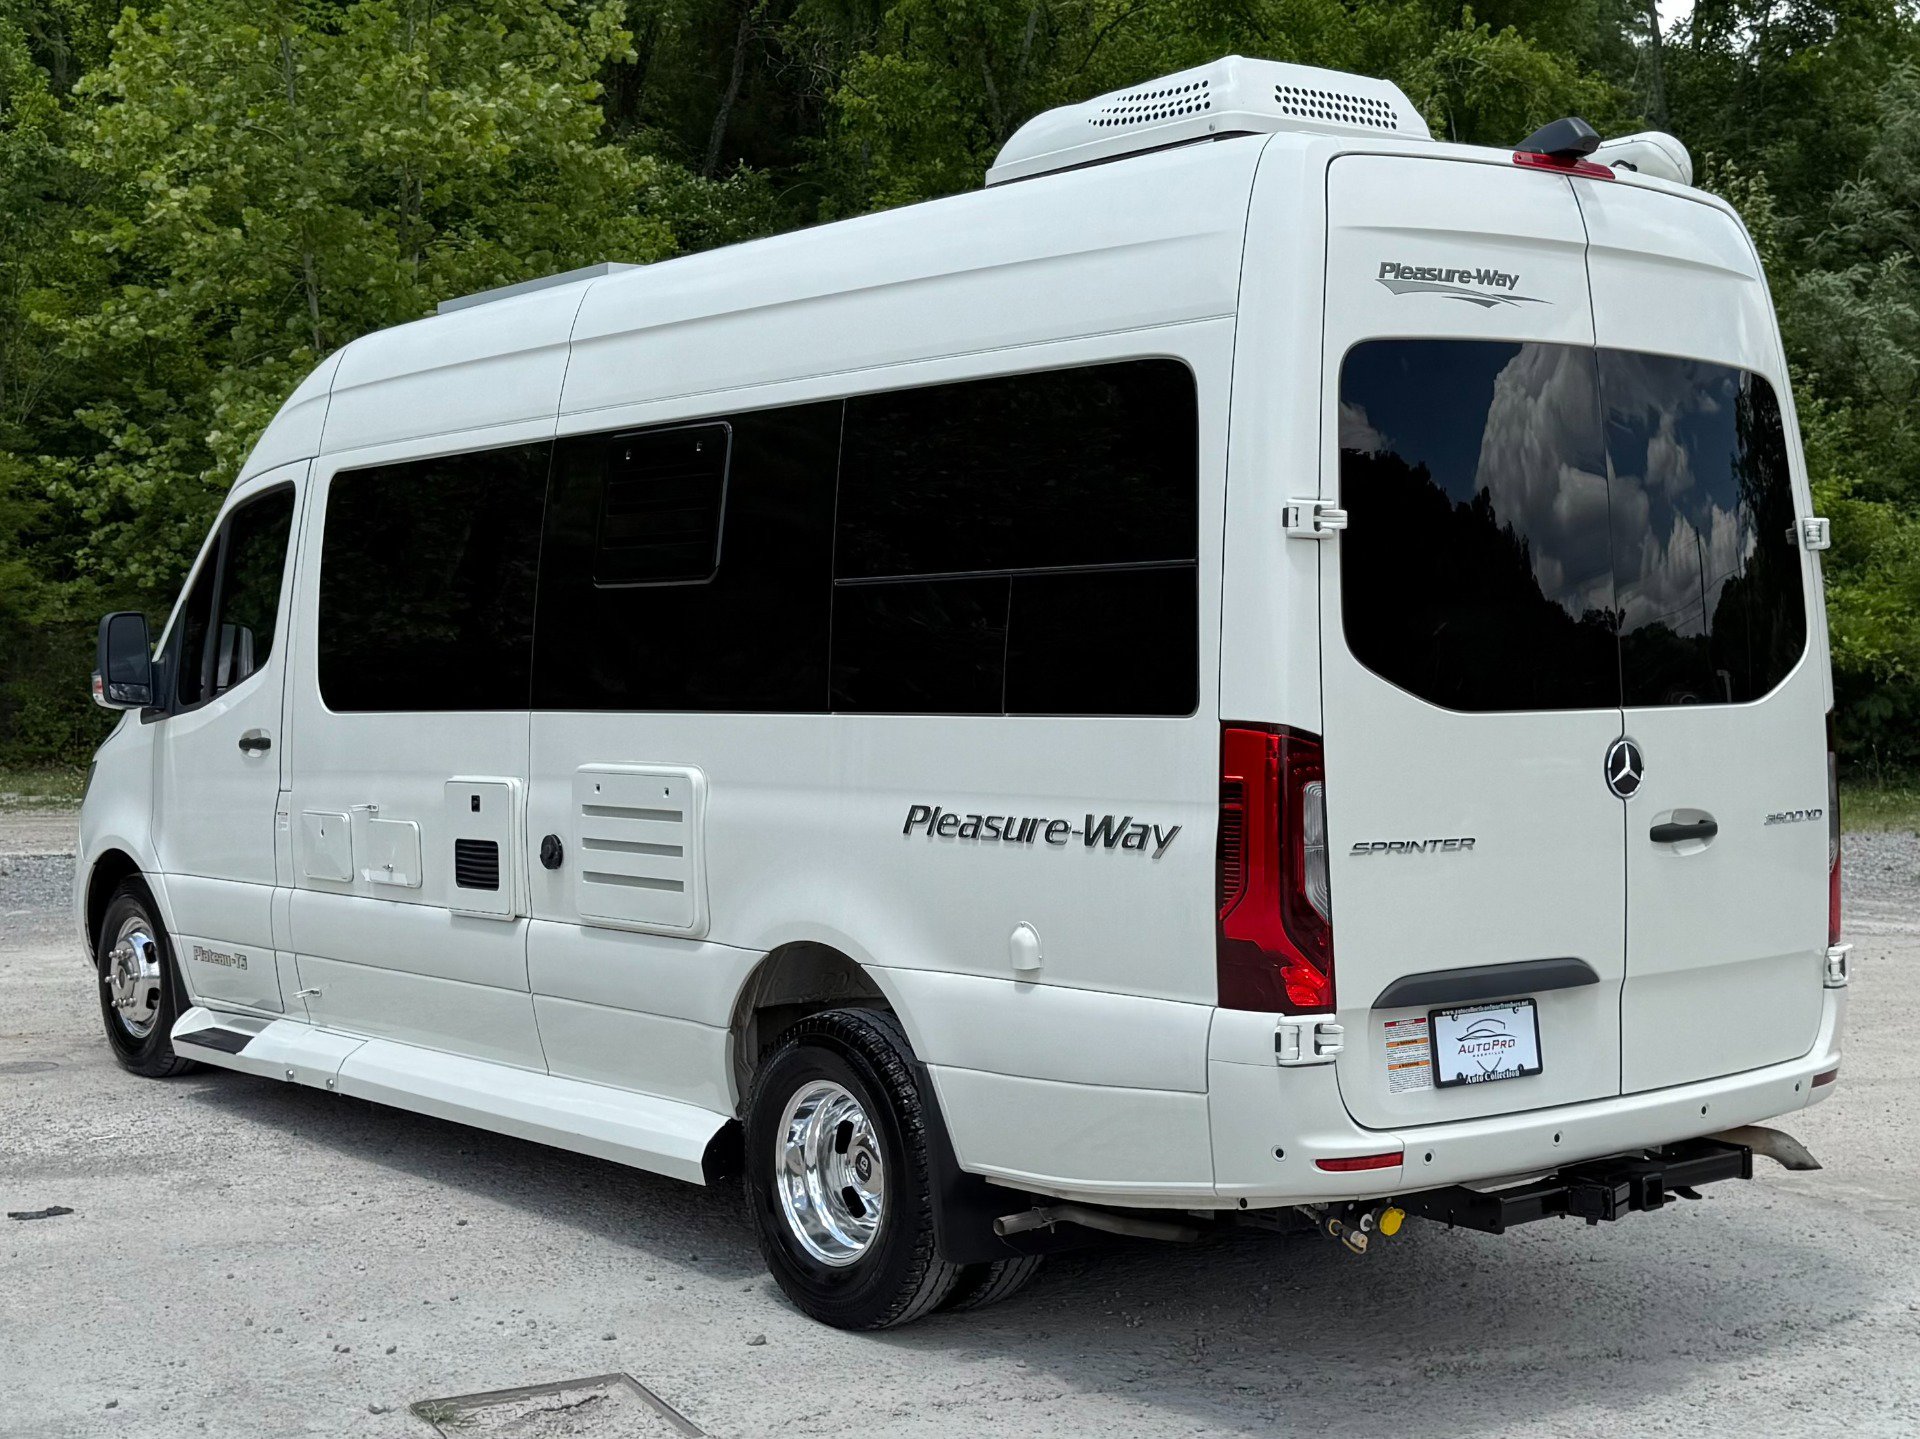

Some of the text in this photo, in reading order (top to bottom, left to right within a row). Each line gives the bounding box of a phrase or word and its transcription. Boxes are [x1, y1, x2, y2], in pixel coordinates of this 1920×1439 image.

[1379, 262, 1519, 290] Pleasure-Way
[902, 804, 1182, 859] Pleasure-Way
[1349, 837, 1476, 856] SPRINTER
